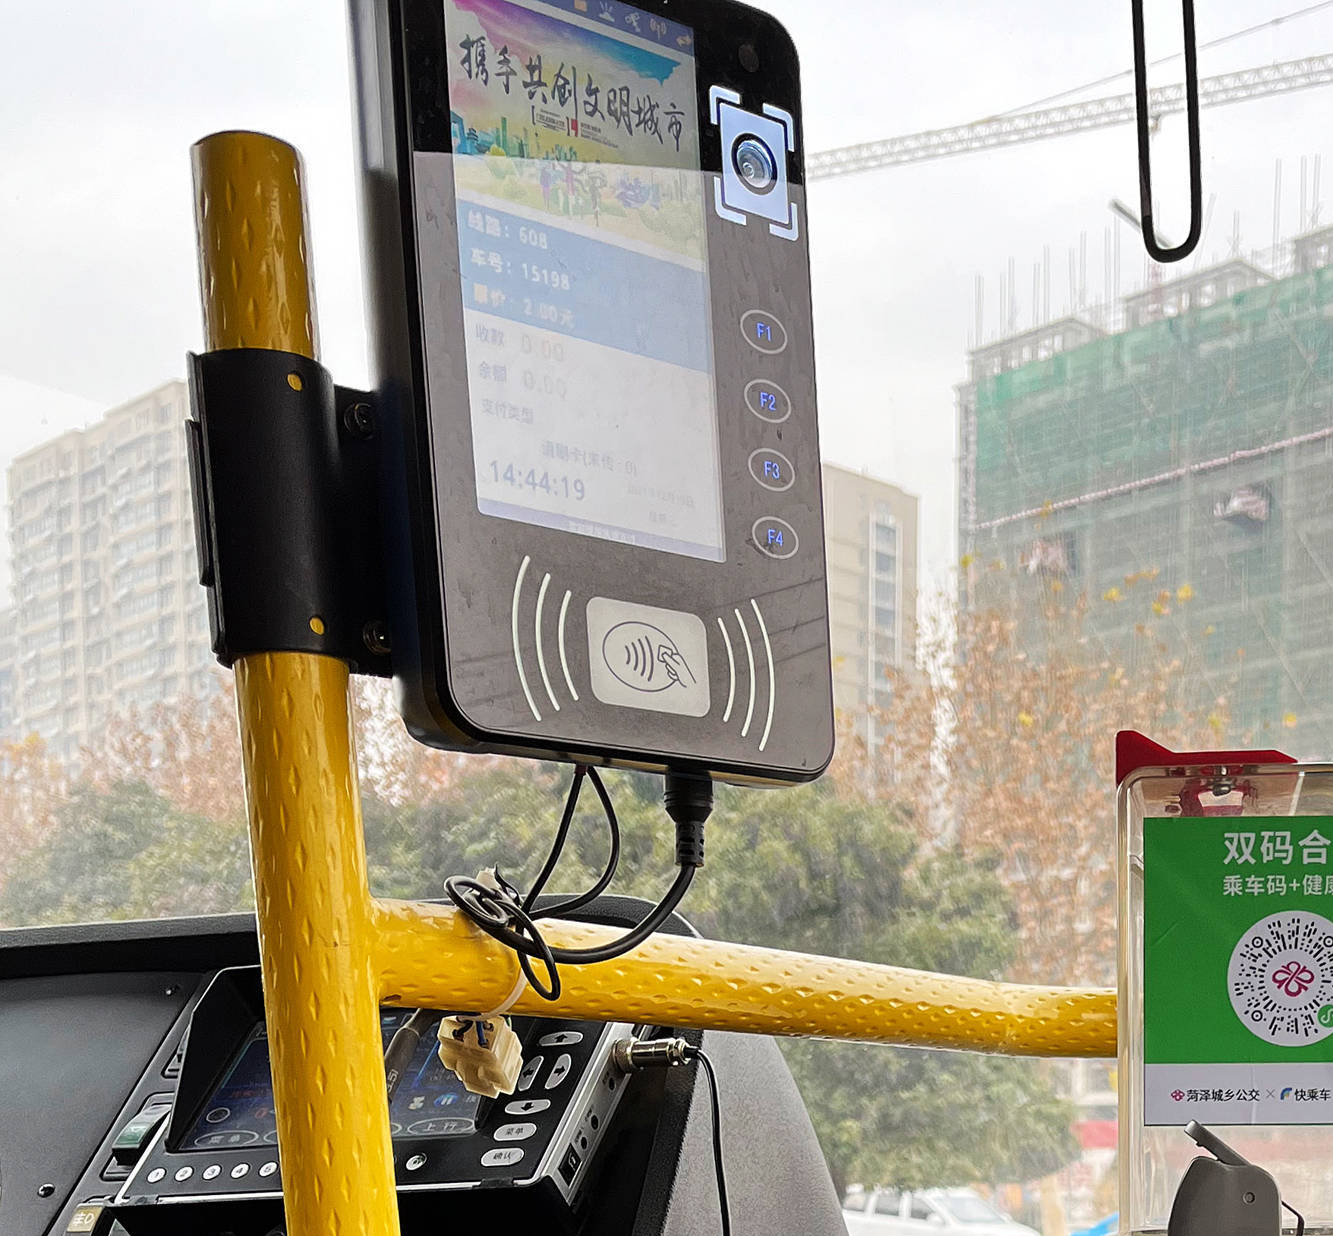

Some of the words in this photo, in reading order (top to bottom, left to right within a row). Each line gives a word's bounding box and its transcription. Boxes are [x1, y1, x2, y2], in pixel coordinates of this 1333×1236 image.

[459, 34, 686, 153] 携手共创文明城市
[756, 323, 772, 342] F1
[760, 392, 777, 411] F2
[764, 461, 780, 480] F3
[489, 460, 586, 501] 14:44:19
[767, 529, 784, 547] F4
[1186, 1087, 1260, 1102] 菏泽城乡公交
[1294, 1087, 1332, 1101] 快乘车
